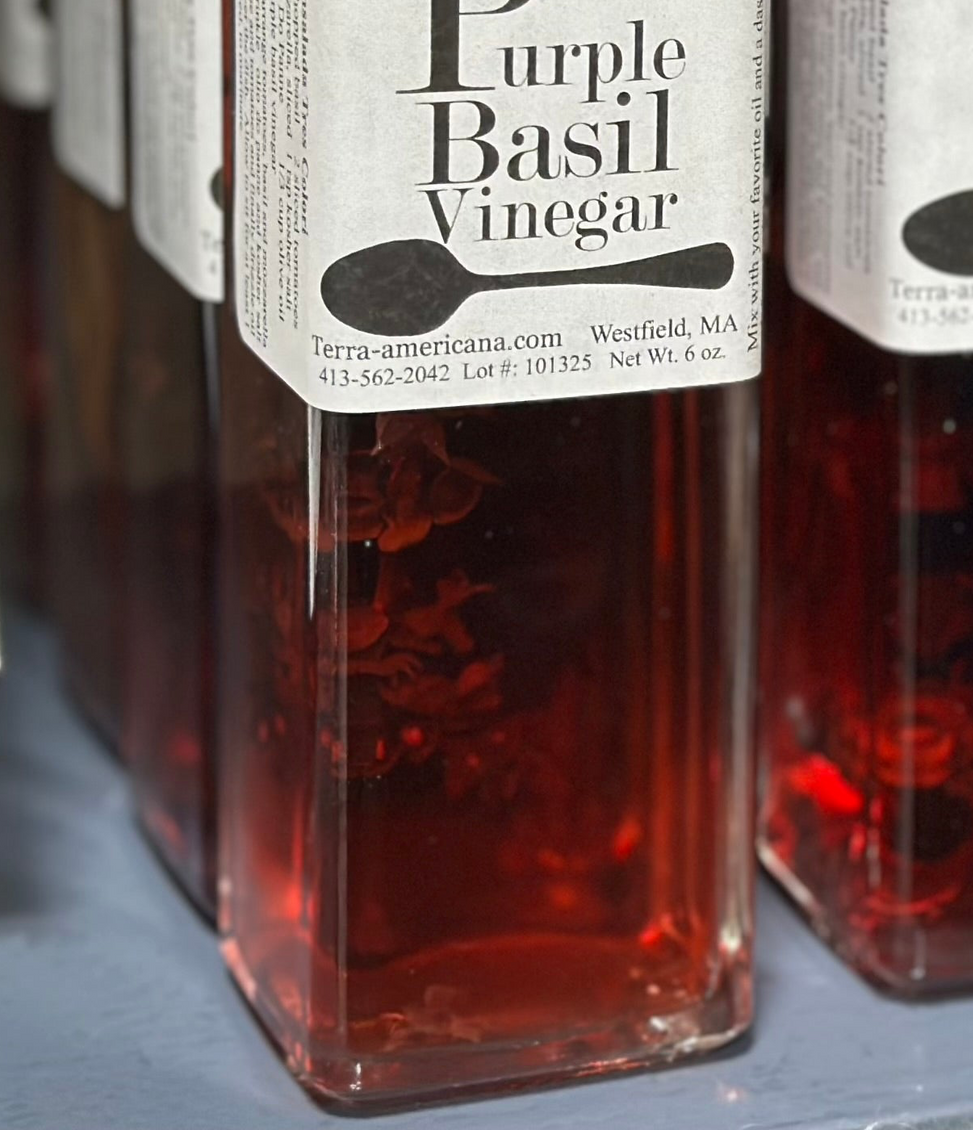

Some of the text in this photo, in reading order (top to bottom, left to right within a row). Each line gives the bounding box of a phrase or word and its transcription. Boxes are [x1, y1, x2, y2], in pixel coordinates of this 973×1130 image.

[755, 39, 763, 49] a
[752, 55, 763, 90] and
[751, 97, 762, 123] oil
[414, 89, 680, 187] Basil
[749, 129, 762, 204] favorite
[417, 186, 679, 252] Vinegar
[752, 211, 763, 253] your
[748, 261, 759, 305] with
[311, 330, 563, 361] Terra-americana.com
[590, 314, 738, 346] Westfield, MA
[747, 309, 759, 353] Mix
[318, 346, 727, 387] 413-562-2042 Lot #: 101325 Net Wt. 6 oz.
